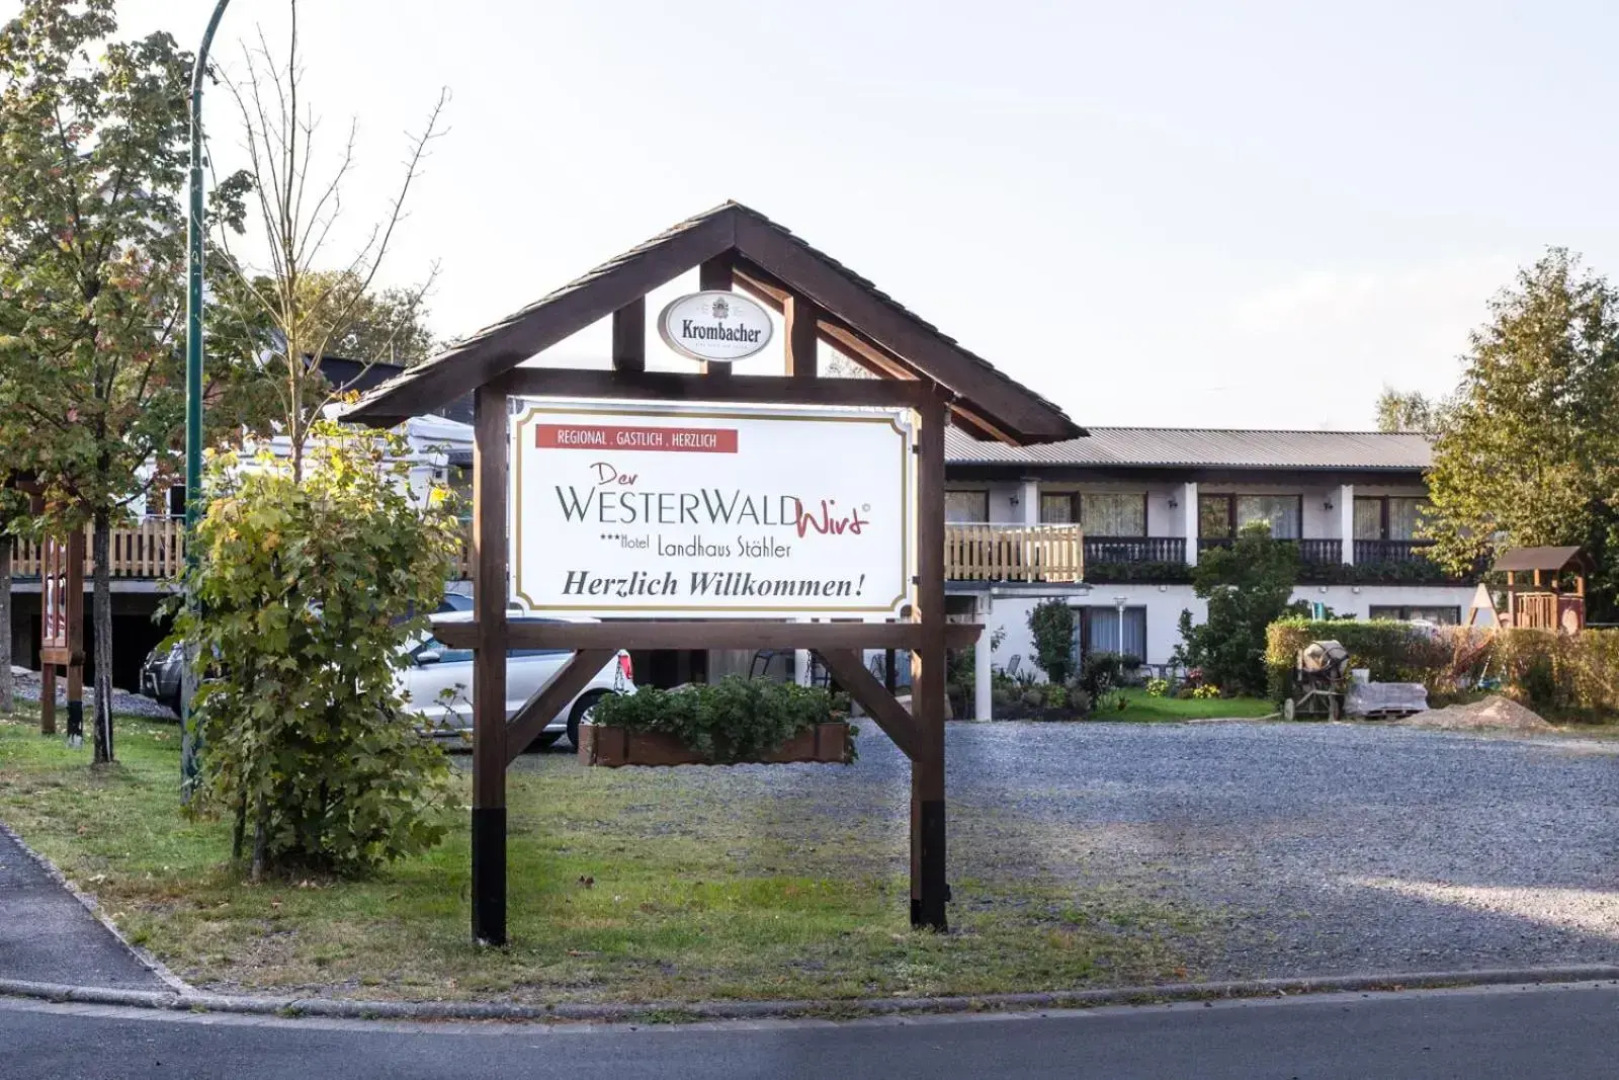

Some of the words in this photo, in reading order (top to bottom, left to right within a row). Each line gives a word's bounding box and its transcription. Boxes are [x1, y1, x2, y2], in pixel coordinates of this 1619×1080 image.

[682, 319, 761, 342] Krombacher
[557, 429, 607, 444] REGIONAL
[616, 431, 663, 446] GASTLICH
[672, 432, 717, 448] HERZLICH
[590, 462, 638, 485] Der
[658, 534, 731, 557] Landhaus
[737, 535, 791, 558] Stähler
[562, 570, 678, 598] Herzlich
[690, 572, 866, 597] Willkommen!
